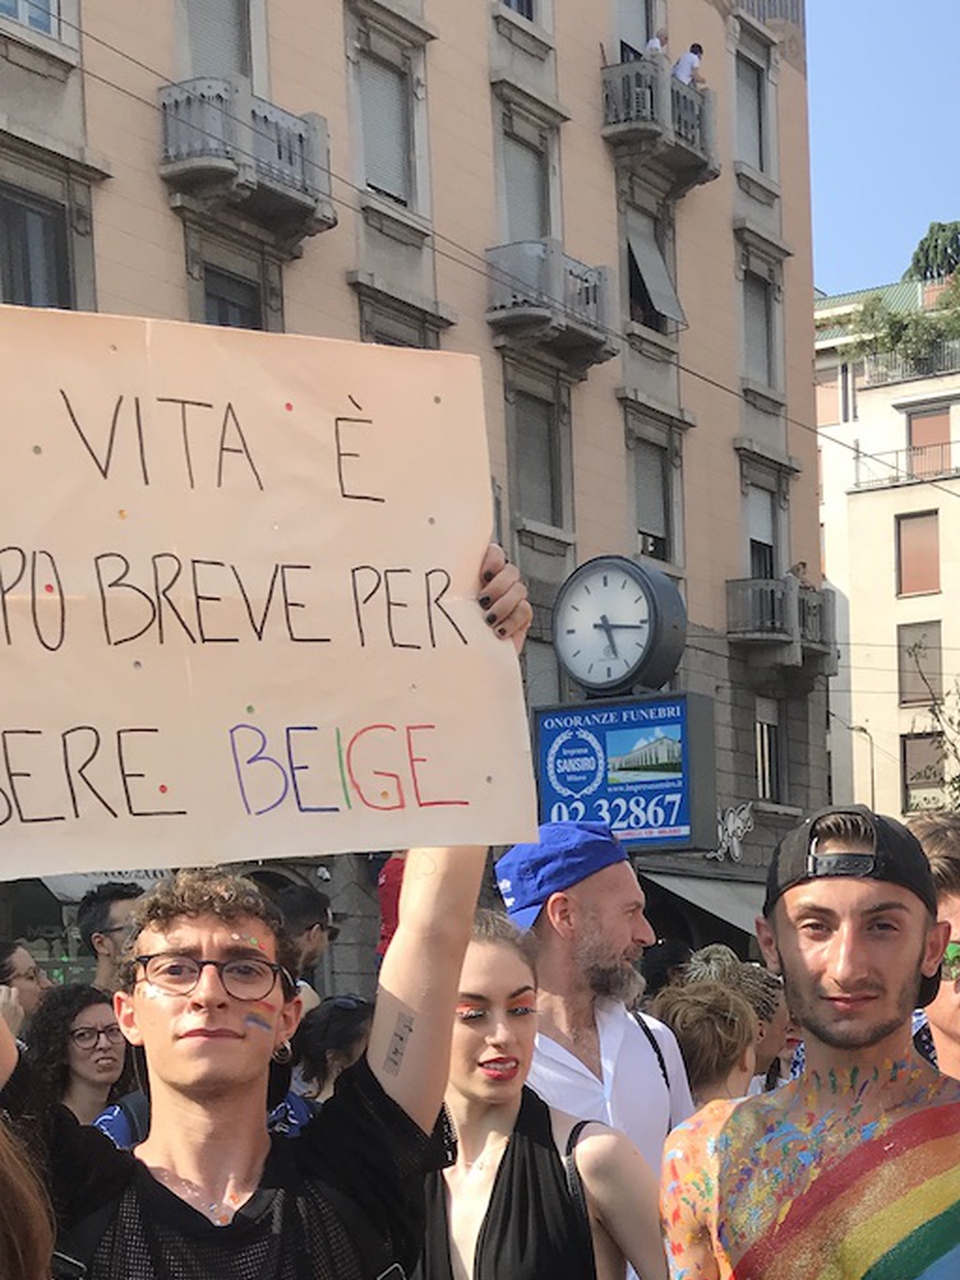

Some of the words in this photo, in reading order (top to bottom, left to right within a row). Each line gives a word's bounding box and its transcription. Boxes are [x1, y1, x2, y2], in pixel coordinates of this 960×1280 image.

[60, 389, 264, 491] VITA
[335, 394, 386, 502] È
[94, 552, 331, 646] BREVE
[351, 565, 468, 649] PER
[544, 712, 618, 730] ONORANZE
[622, 706, 681, 723] FUNEBRI
[0, 726, 187, 824] ERE
[229, 722, 469, 815] BEIGE
[593, 794, 682, 828] 32867
